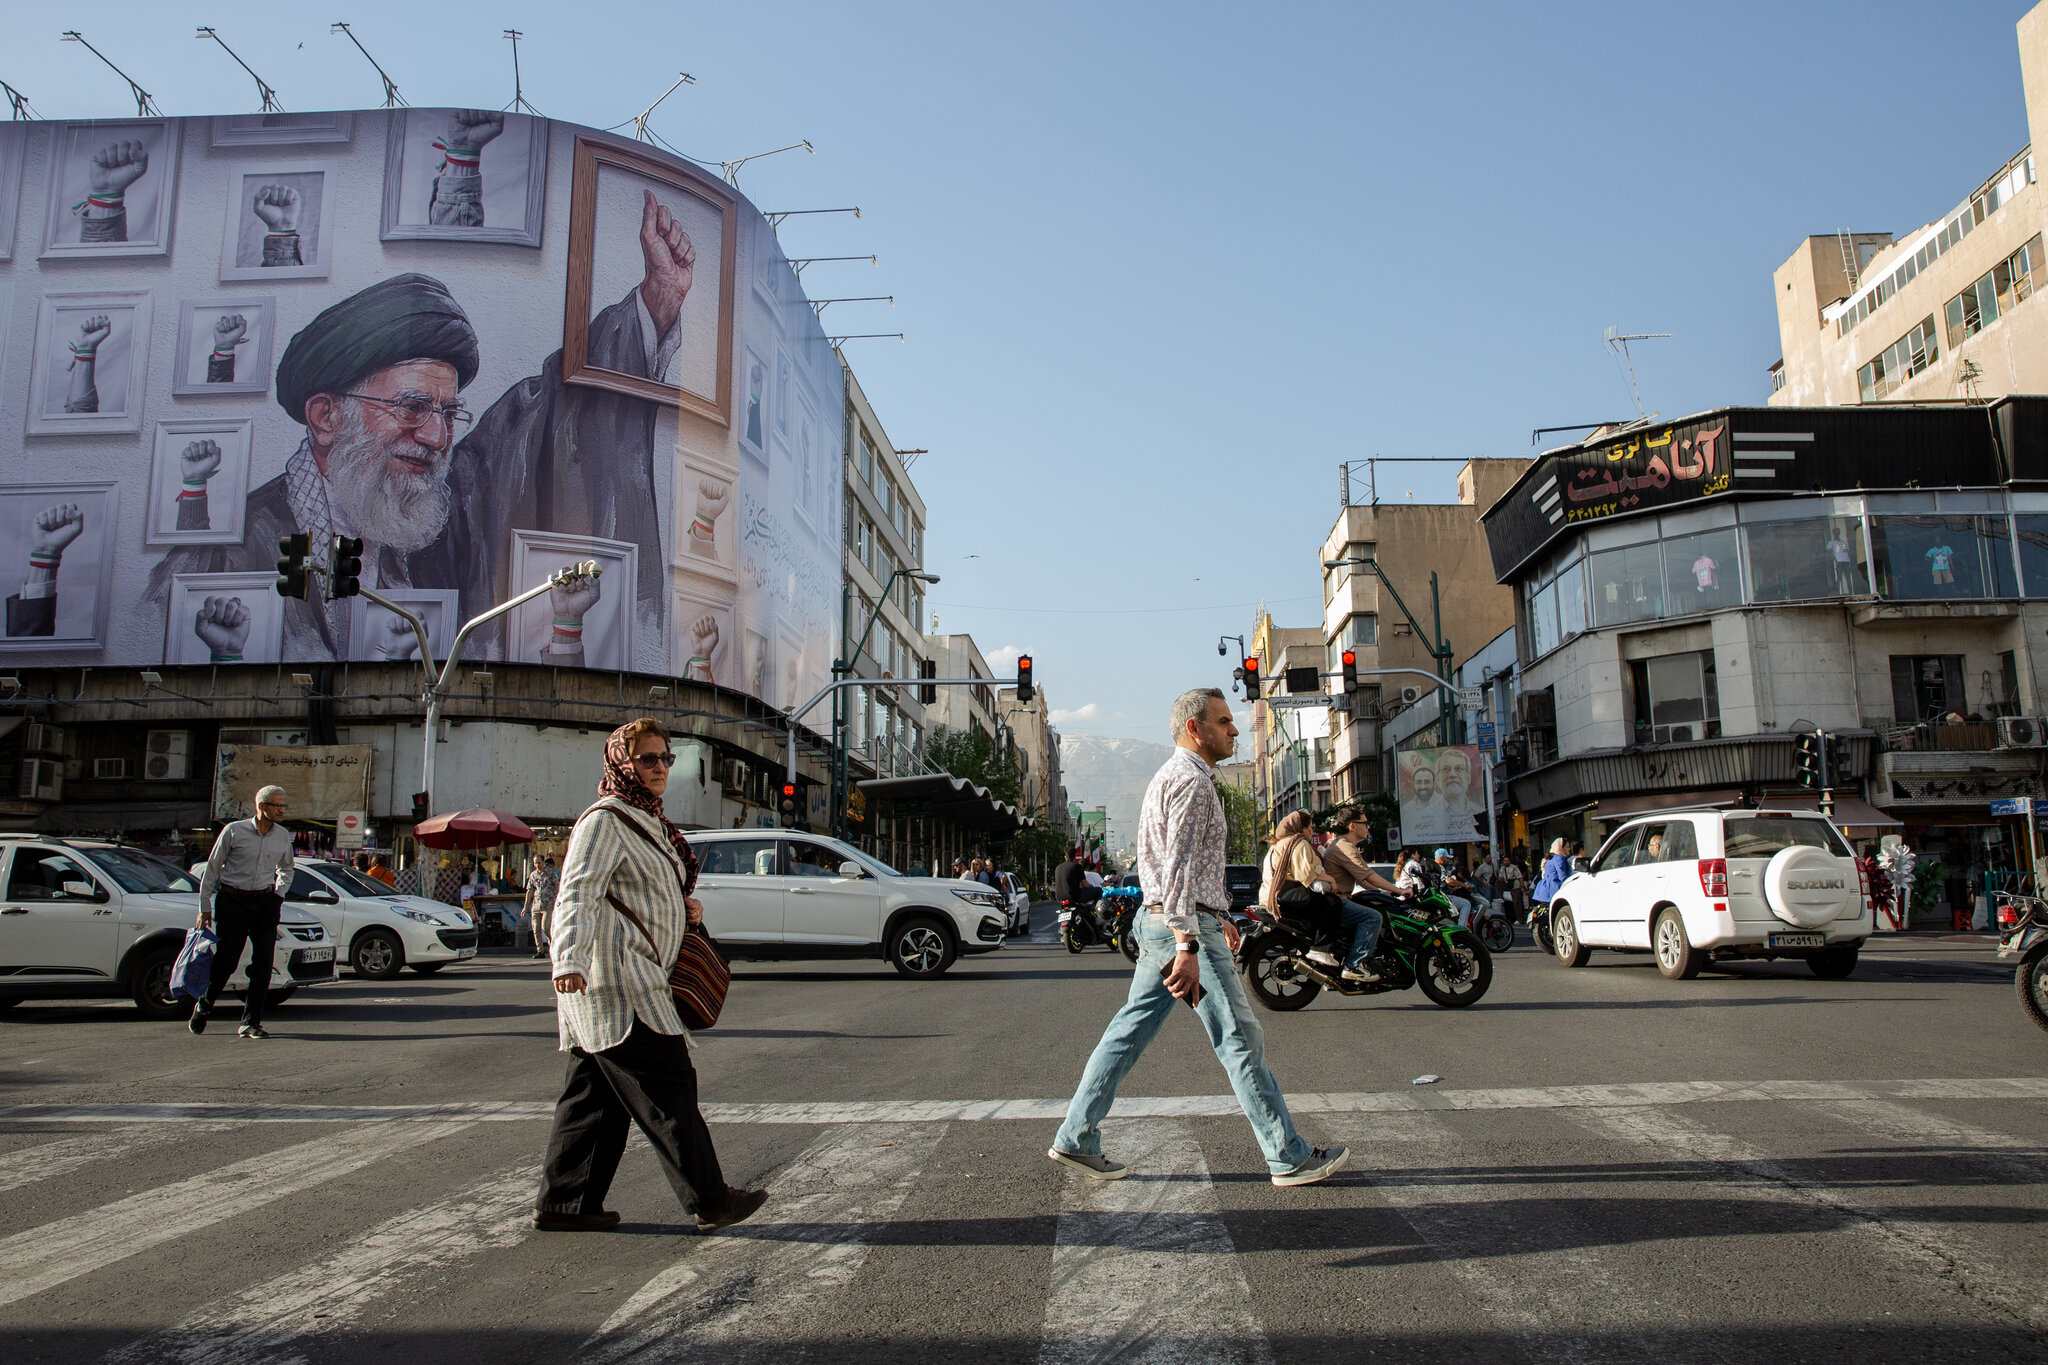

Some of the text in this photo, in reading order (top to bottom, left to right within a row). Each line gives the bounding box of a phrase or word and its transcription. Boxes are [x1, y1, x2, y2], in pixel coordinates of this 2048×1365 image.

[1568, 424, 1724, 507] آناهیت
[1703, 474, 1729, 496] تلفن
[313, 758, 318, 767] و
[320, 754, 335, 765] لاک
[336, 754, 358, 767] دنیای
[1786, 879, 1845, 890] SUZUKI
